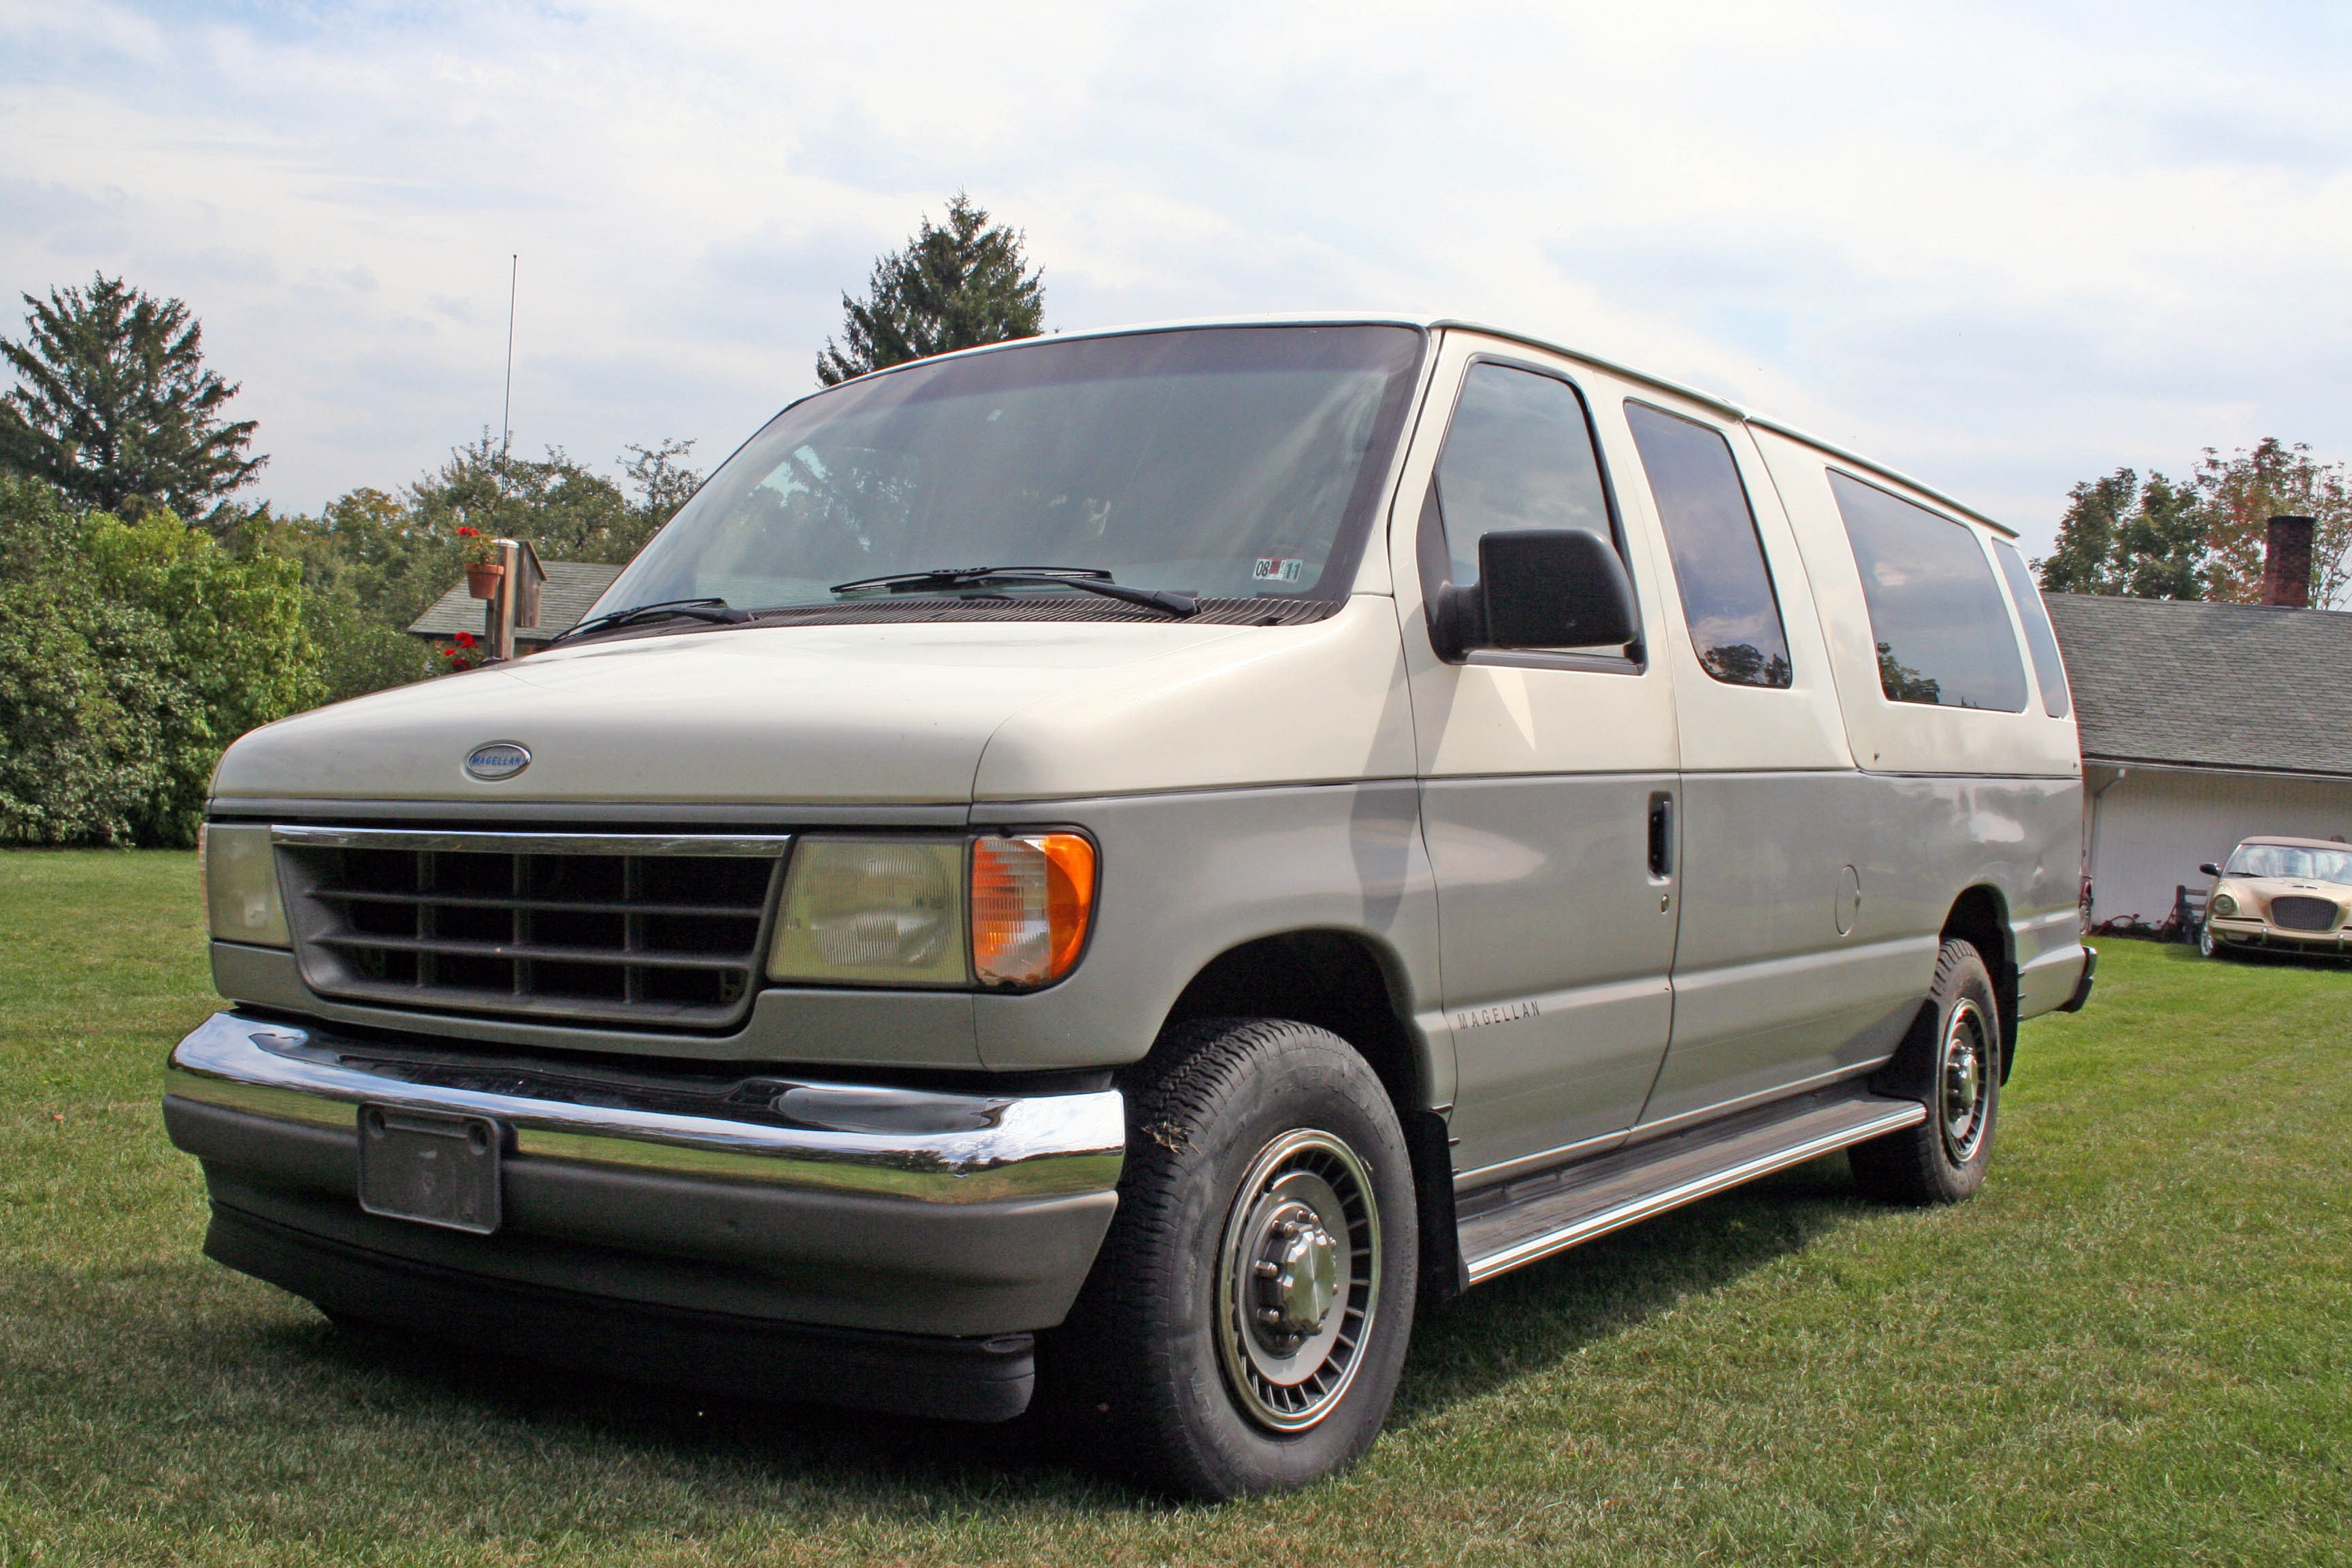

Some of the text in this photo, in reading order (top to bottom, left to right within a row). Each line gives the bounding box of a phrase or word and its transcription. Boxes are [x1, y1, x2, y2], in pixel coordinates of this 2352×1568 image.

[1256, 561, 1270, 576] 08
[1286, 562, 1301, 580] 11
[471, 755, 521, 766] MAGELLAN
[1457, 1000, 1540, 1030] MAGELLAN
